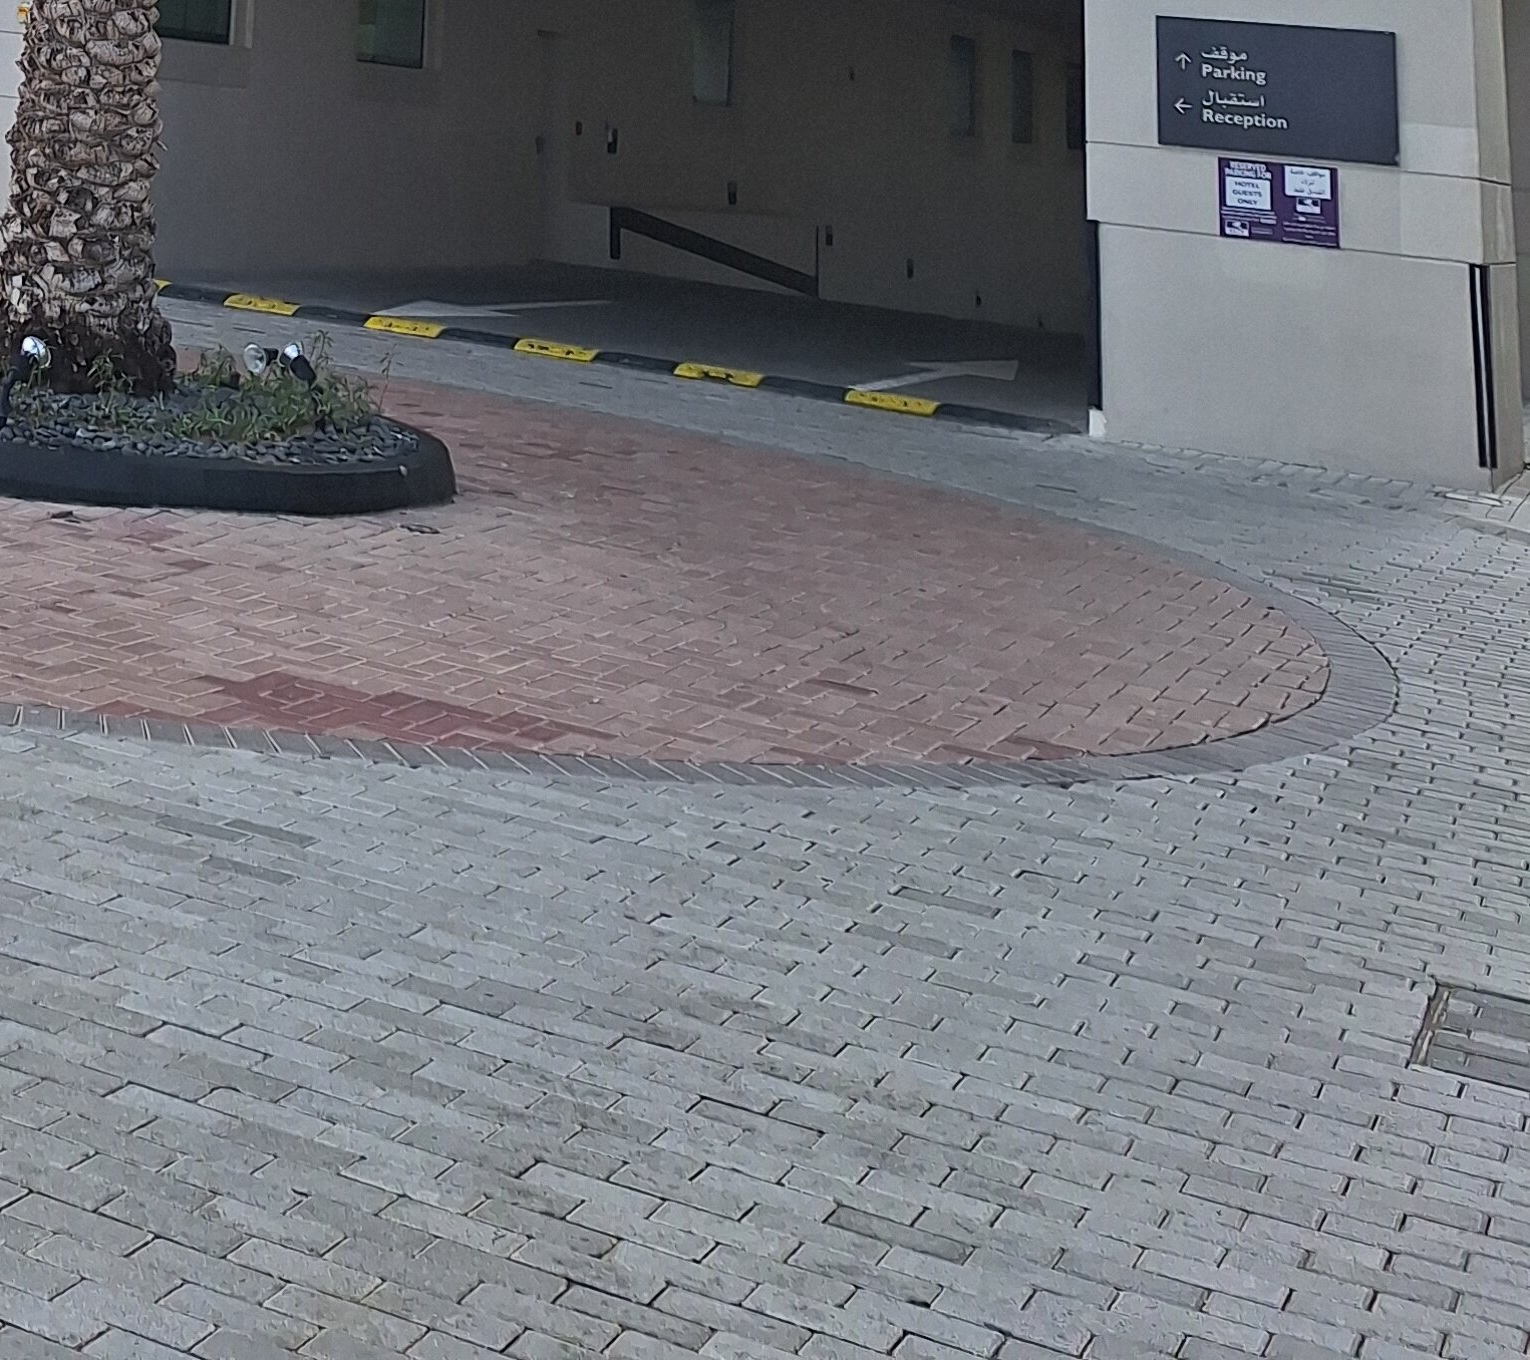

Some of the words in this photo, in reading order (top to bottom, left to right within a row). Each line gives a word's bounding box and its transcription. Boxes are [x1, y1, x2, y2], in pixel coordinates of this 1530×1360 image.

[1201, 46, 1247, 63] موقف
[1202, 63, 1267, 85] Parking
[1202, 90, 1265, 109] استقبال
[1202, 108, 1288, 129] Reception
[1237, 198, 1258, 206] ONLY
